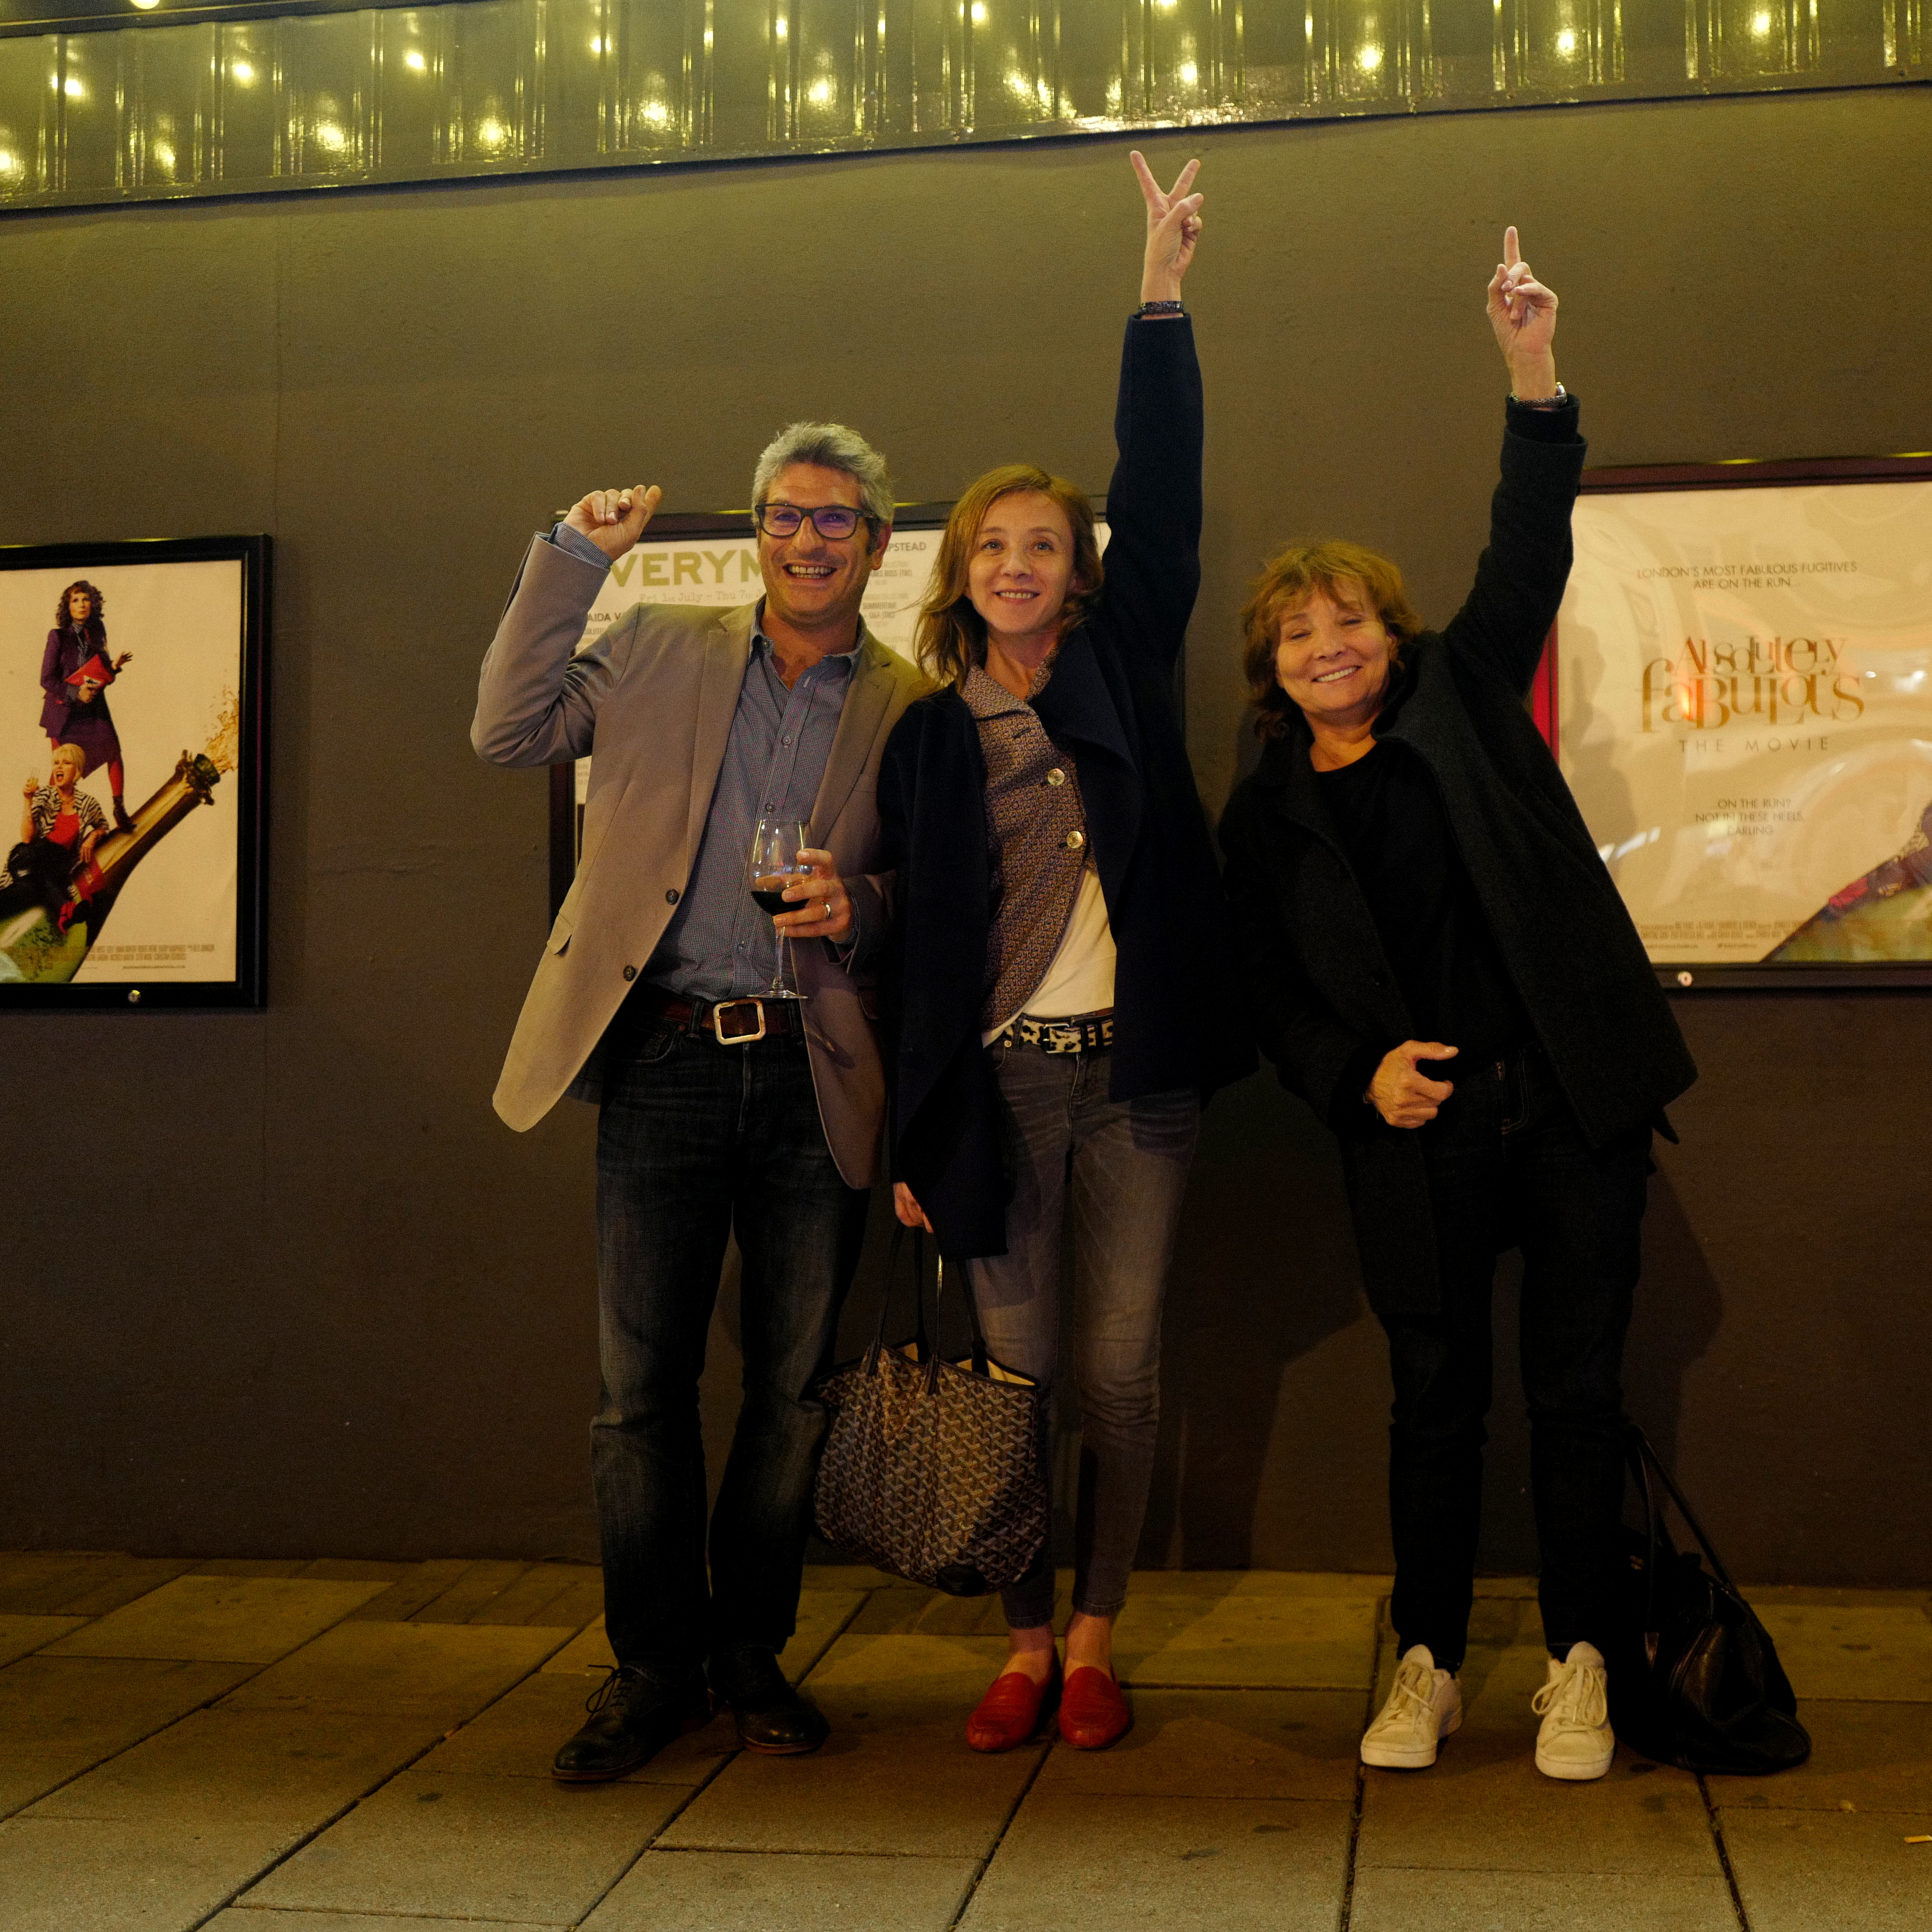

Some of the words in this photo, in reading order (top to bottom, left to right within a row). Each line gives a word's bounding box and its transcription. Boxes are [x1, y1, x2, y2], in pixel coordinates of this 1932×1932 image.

[886, 542, 927, 552] PSTEAD
[610, 549, 762, 587] VERYM
[1637, 565, 1700, 579] LONDON'S
[1703, 565, 1737, 577] MOST
[1741, 563, 1798, 576] FABULOUS
[1801, 560, 1858, 574] FUGITIVES
[1694, 579, 1715, 590] ARE
[1719, 578, 1739, 590] ON
[1743, 577, 1762, 589] THE
[678, 592, 703, 603] July
[587, 613, 611, 622] AIDA
[1679, 739, 1724, 753] THE
[1746, 736, 1829, 752] MOVIE
[1740, 797, 1758, 809] THE
[1763, 797, 1791, 809] RUN?
[1695, 812, 1718, 823] NOT
[1739, 811, 1767, 822] THESE
